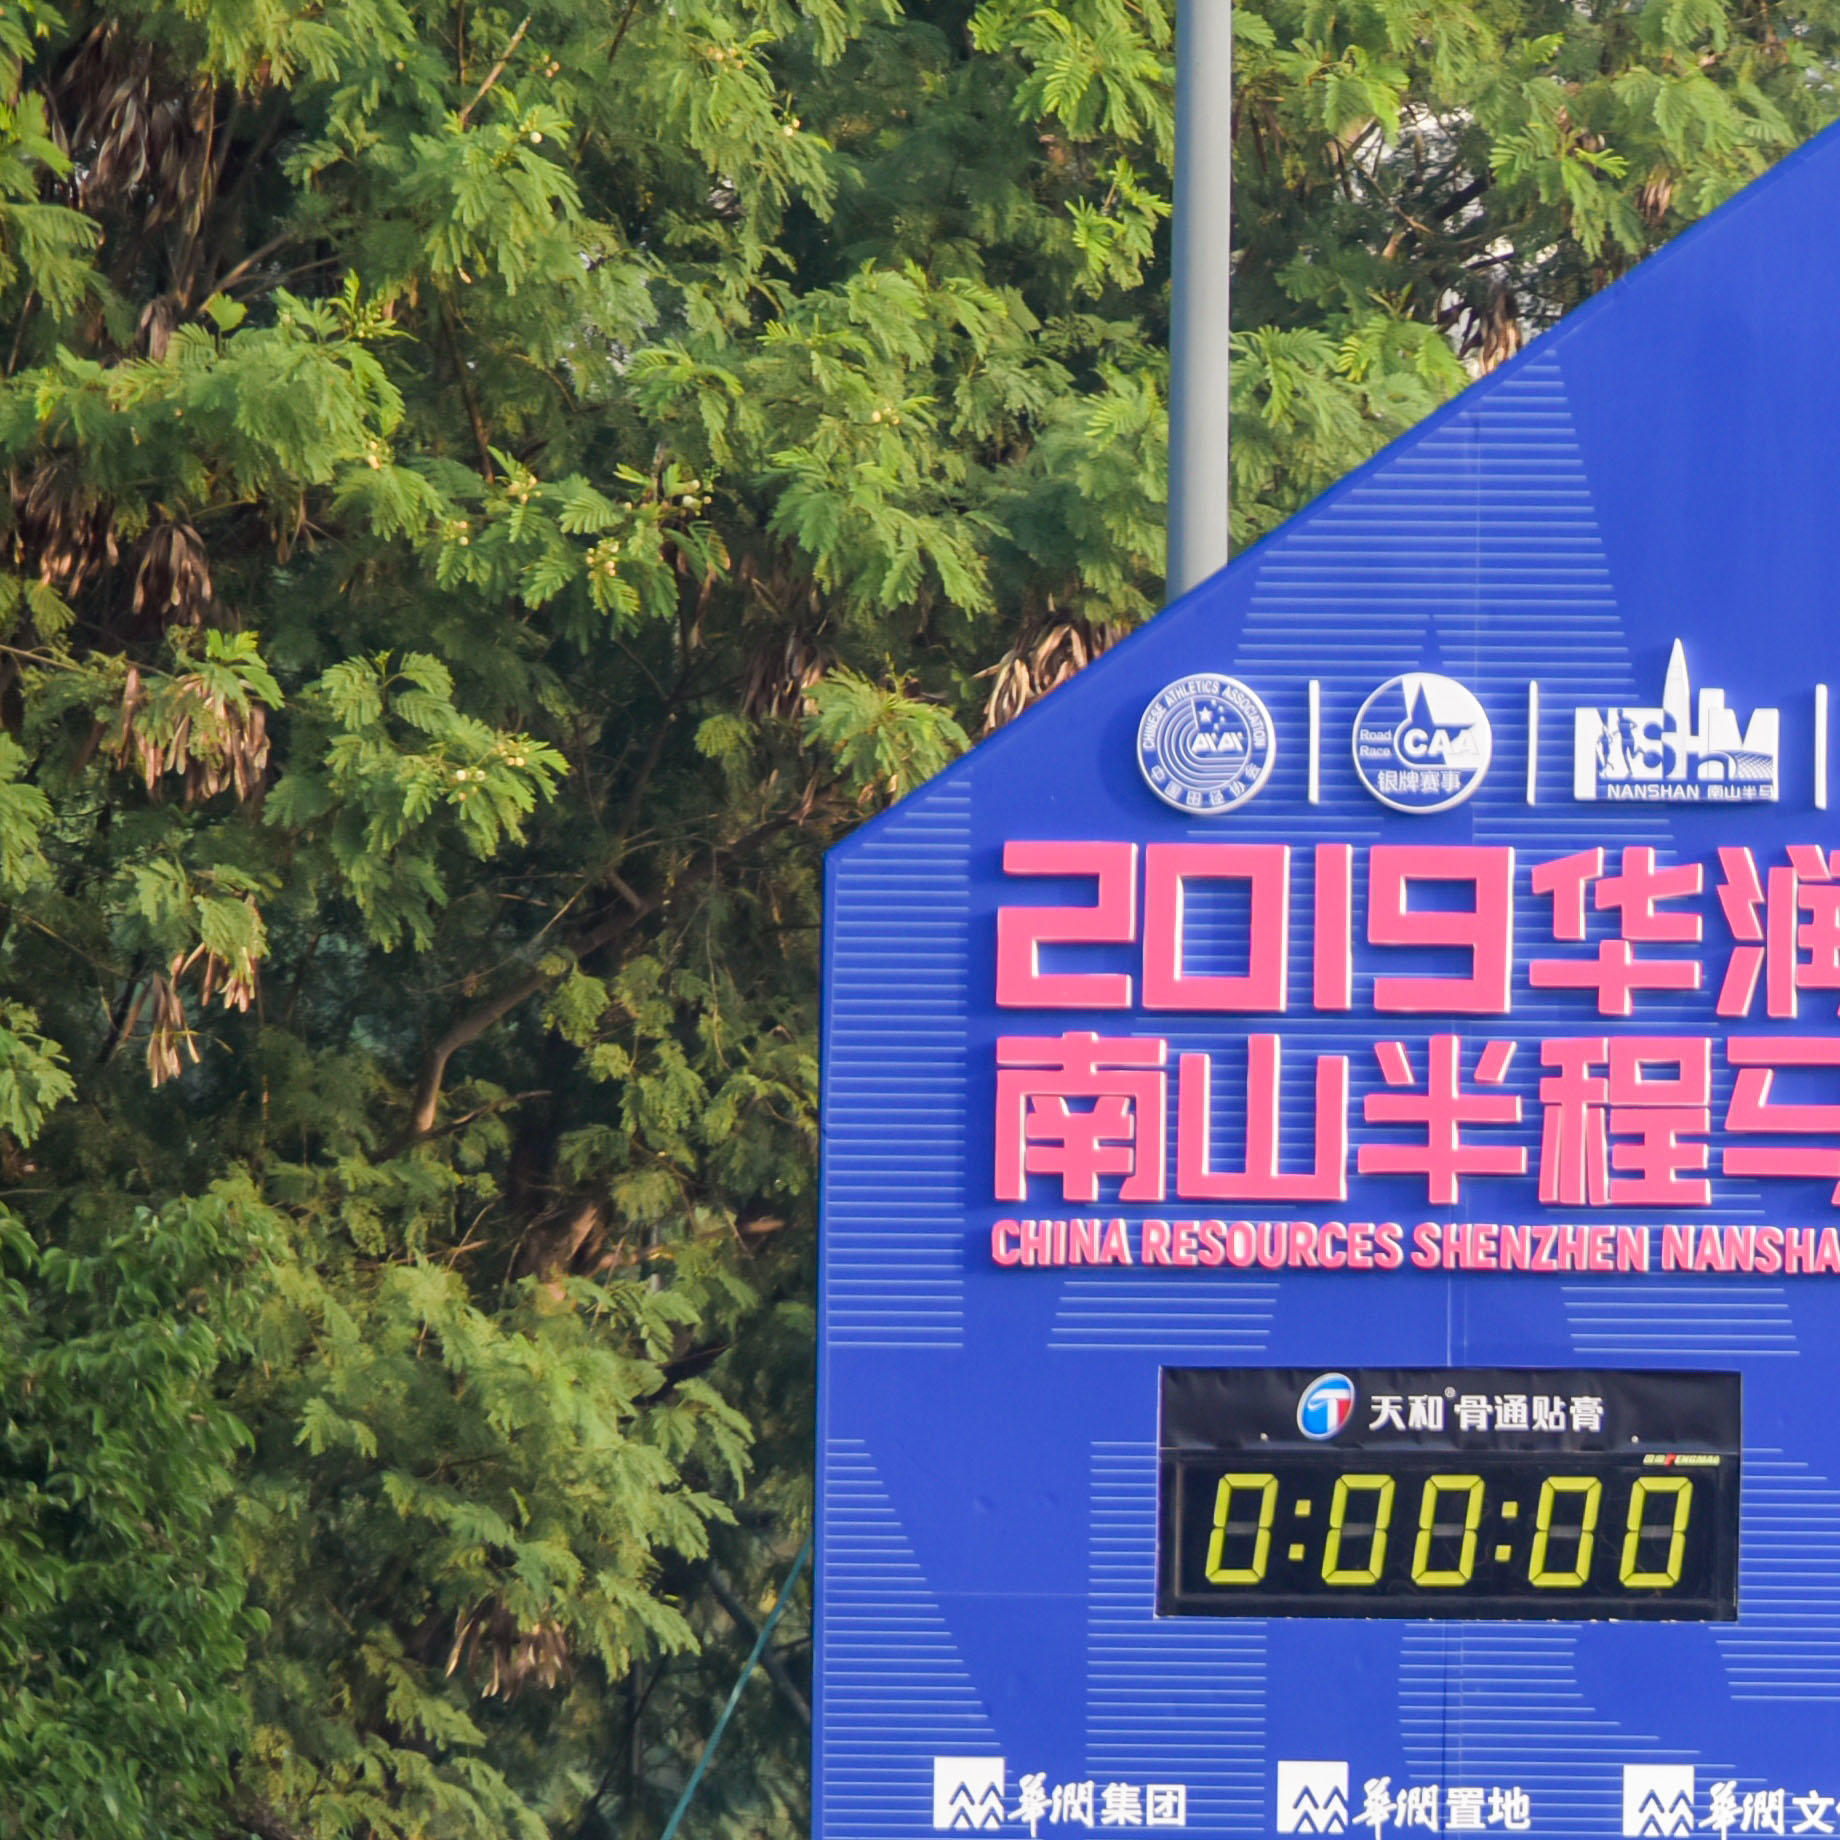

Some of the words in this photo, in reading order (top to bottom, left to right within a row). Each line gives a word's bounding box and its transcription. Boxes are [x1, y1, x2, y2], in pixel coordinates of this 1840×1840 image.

[1166, 680, 1220, 708] ATHLETICS
[1360, 729, 1391, 742] Road
[1377, 769, 1461, 795] 银牌赛事
[1608, 784, 1699, 799] NANSHAN
[991, 1219, 1132, 1266] CHINA
[1141, 1221, 1403, 1268] RESOURCES
[1410, 1223, 1650, 1272] SHENZHEN
[1205, 1473, 1693, 1588] 0:00:00
